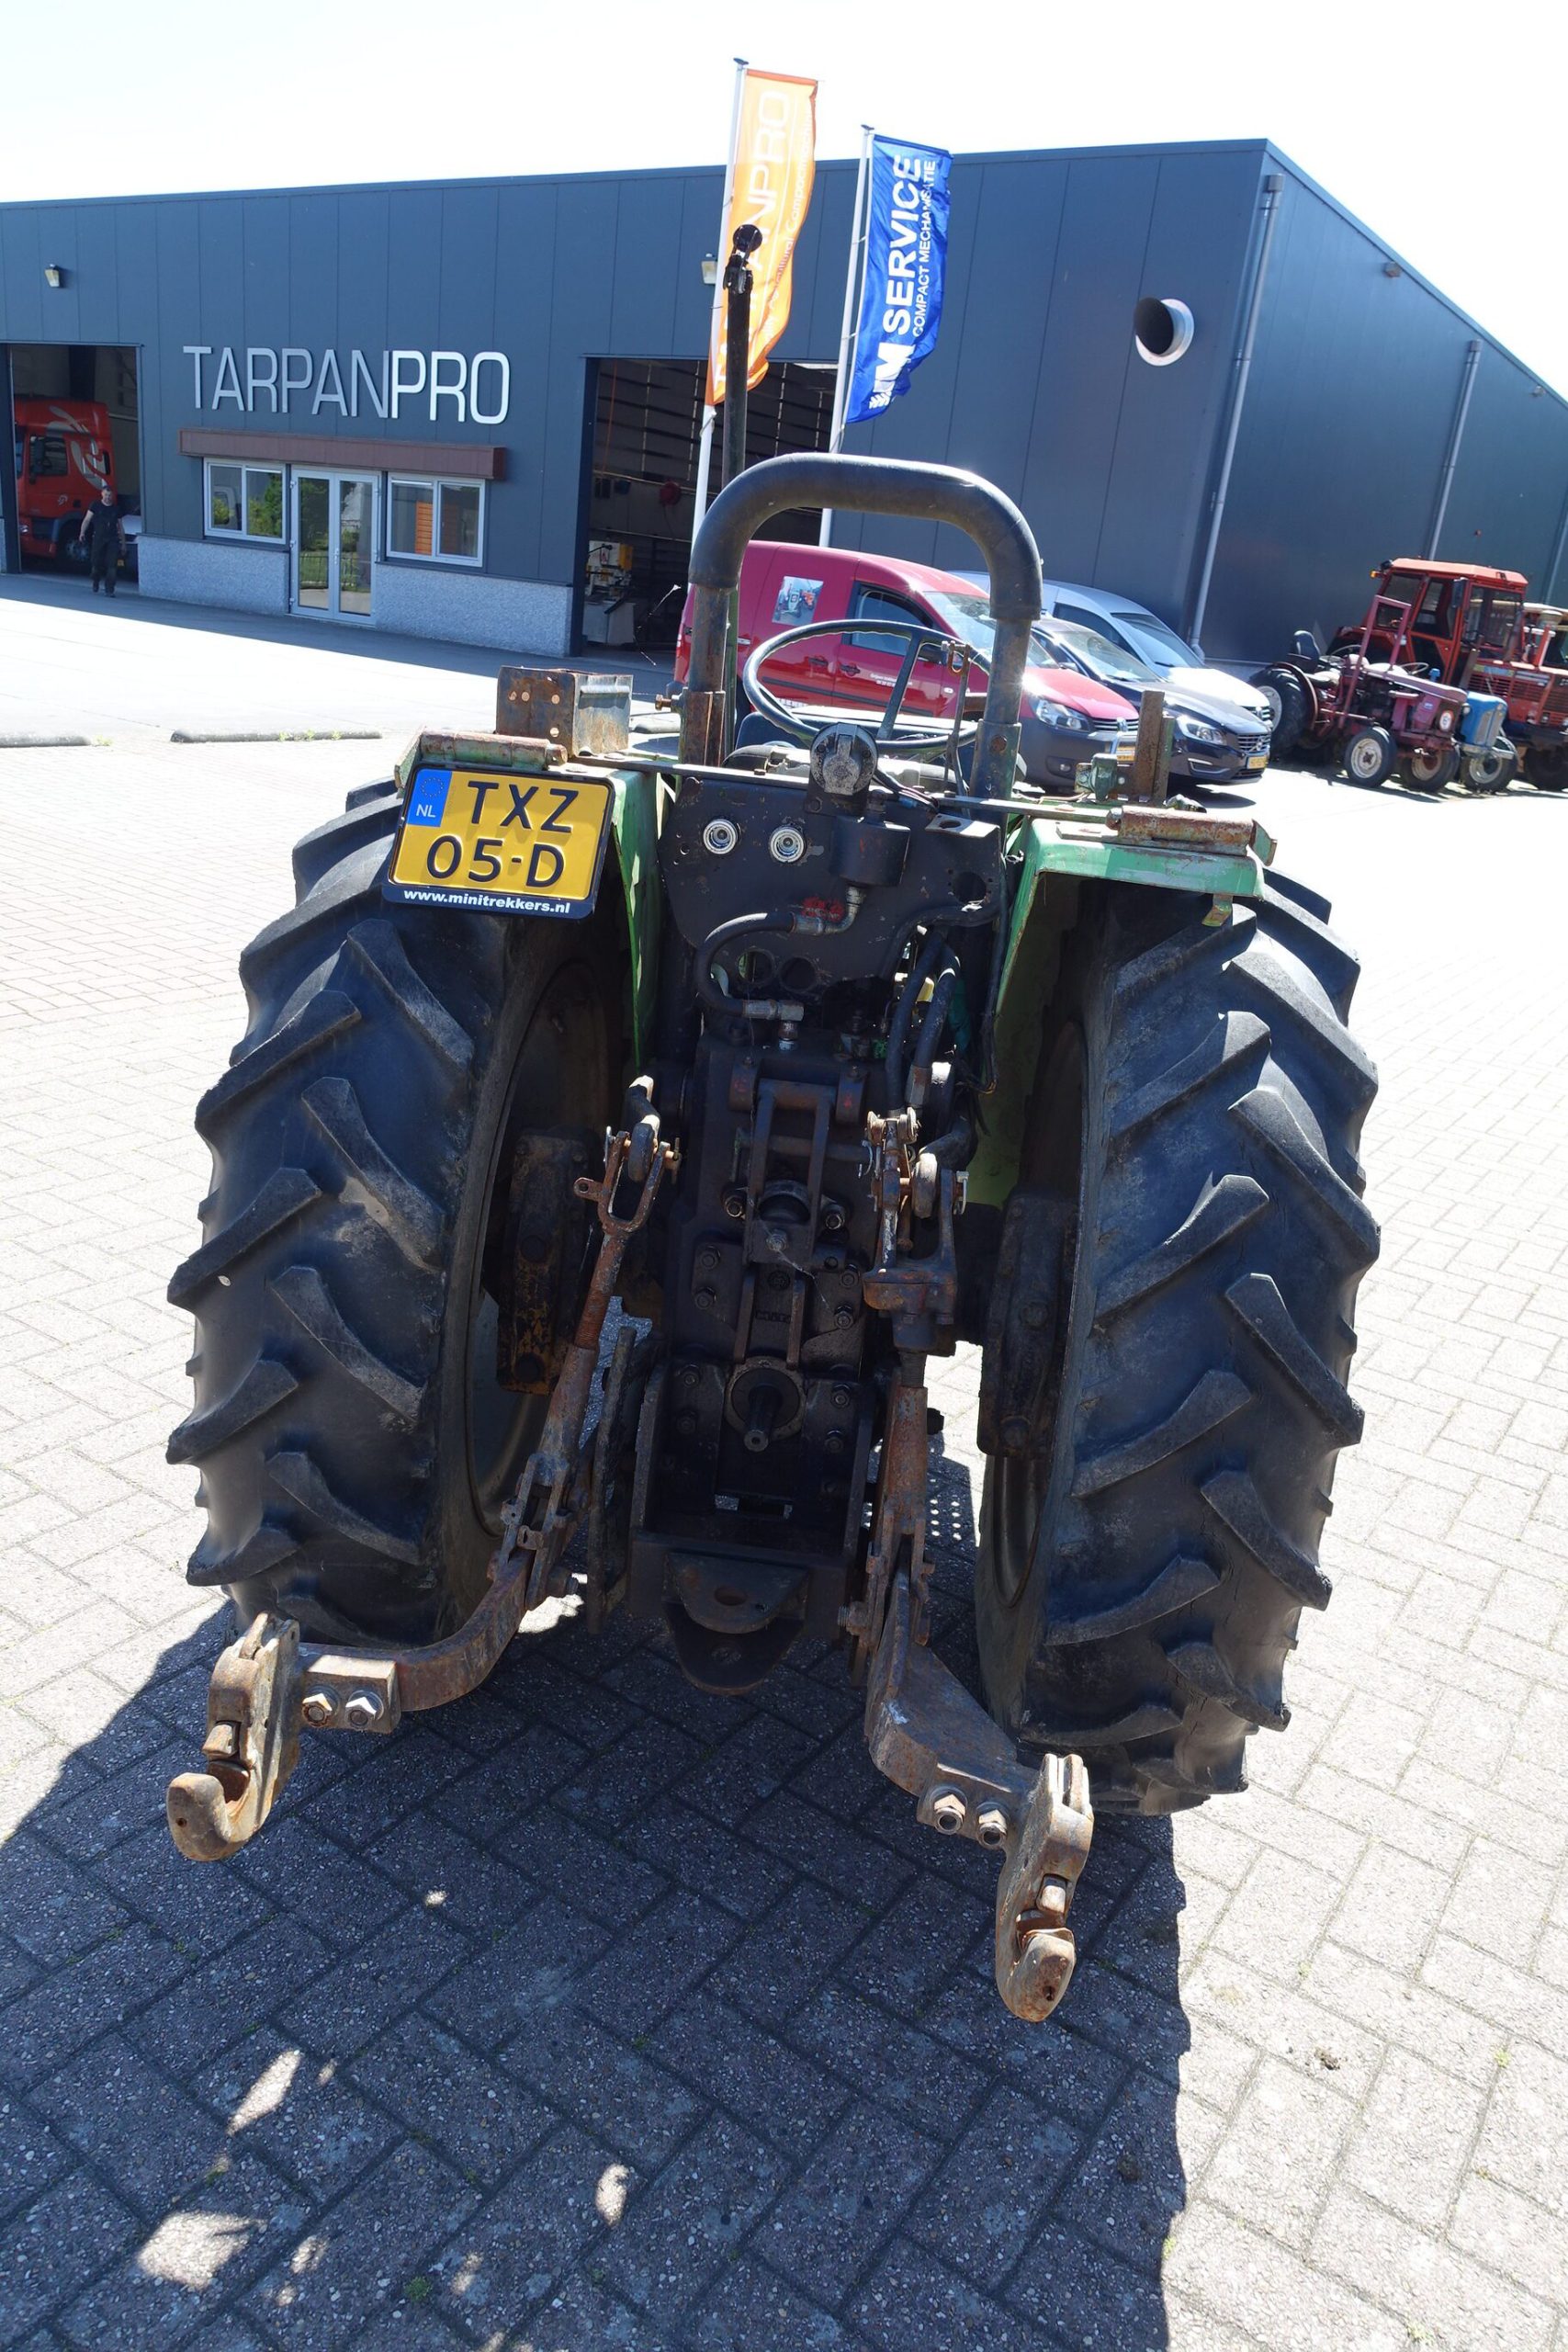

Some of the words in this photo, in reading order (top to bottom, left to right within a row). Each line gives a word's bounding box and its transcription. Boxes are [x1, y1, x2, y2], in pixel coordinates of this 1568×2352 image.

[883, 154, 921, 334] SERVICE
[912, 265, 930, 337] COMPACT
[183, 345, 510, 424] TARPANPRO
[416, 804, 435, 818] NL
[468, 781, 579, 833] TXZ
[426, 835, 565, 888] 05-D
[403, 889, 570, 914] www.minitrekkers.nl
